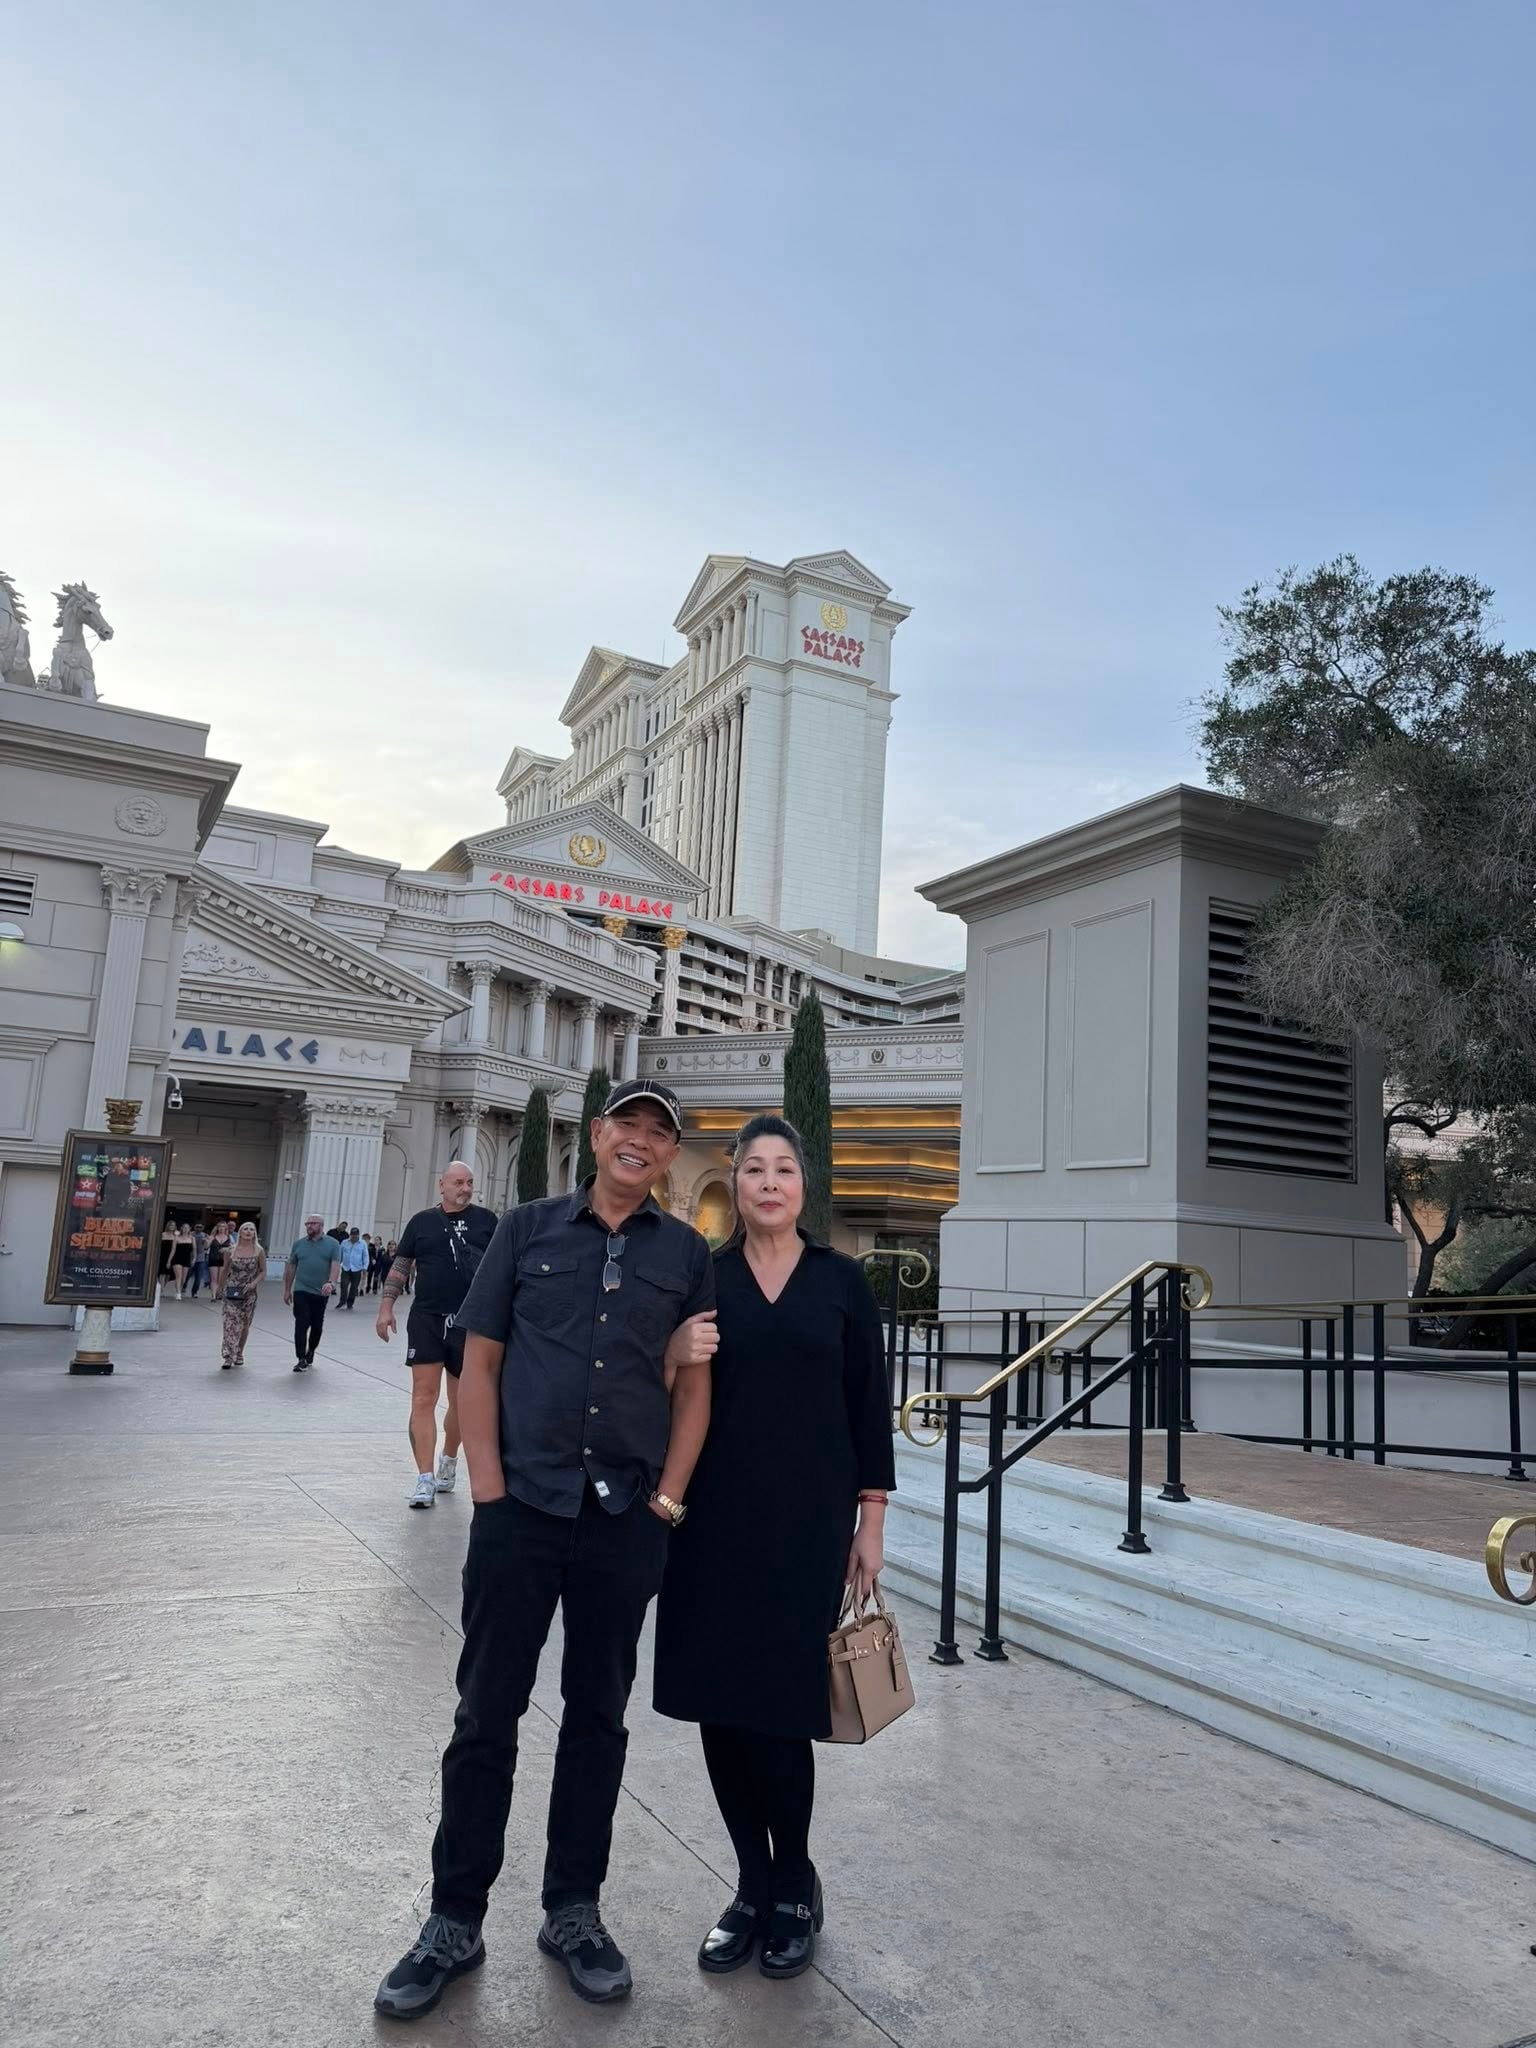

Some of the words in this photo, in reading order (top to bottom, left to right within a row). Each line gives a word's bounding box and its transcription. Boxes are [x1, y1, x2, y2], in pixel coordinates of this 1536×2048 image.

[801, 625, 865, 654] CAESARS
[803, 640, 861, 668] PALACE
[598, 891, 673, 919] PALACE
[172, 1027, 319, 1064] ALACE
[84, 1216, 135, 1234] BLAKE
[70, 1232, 144, 1252] SHELTON
[74, 1266, 88, 1274] THE
[89, 1267, 133, 1276] COLOSSEUM
